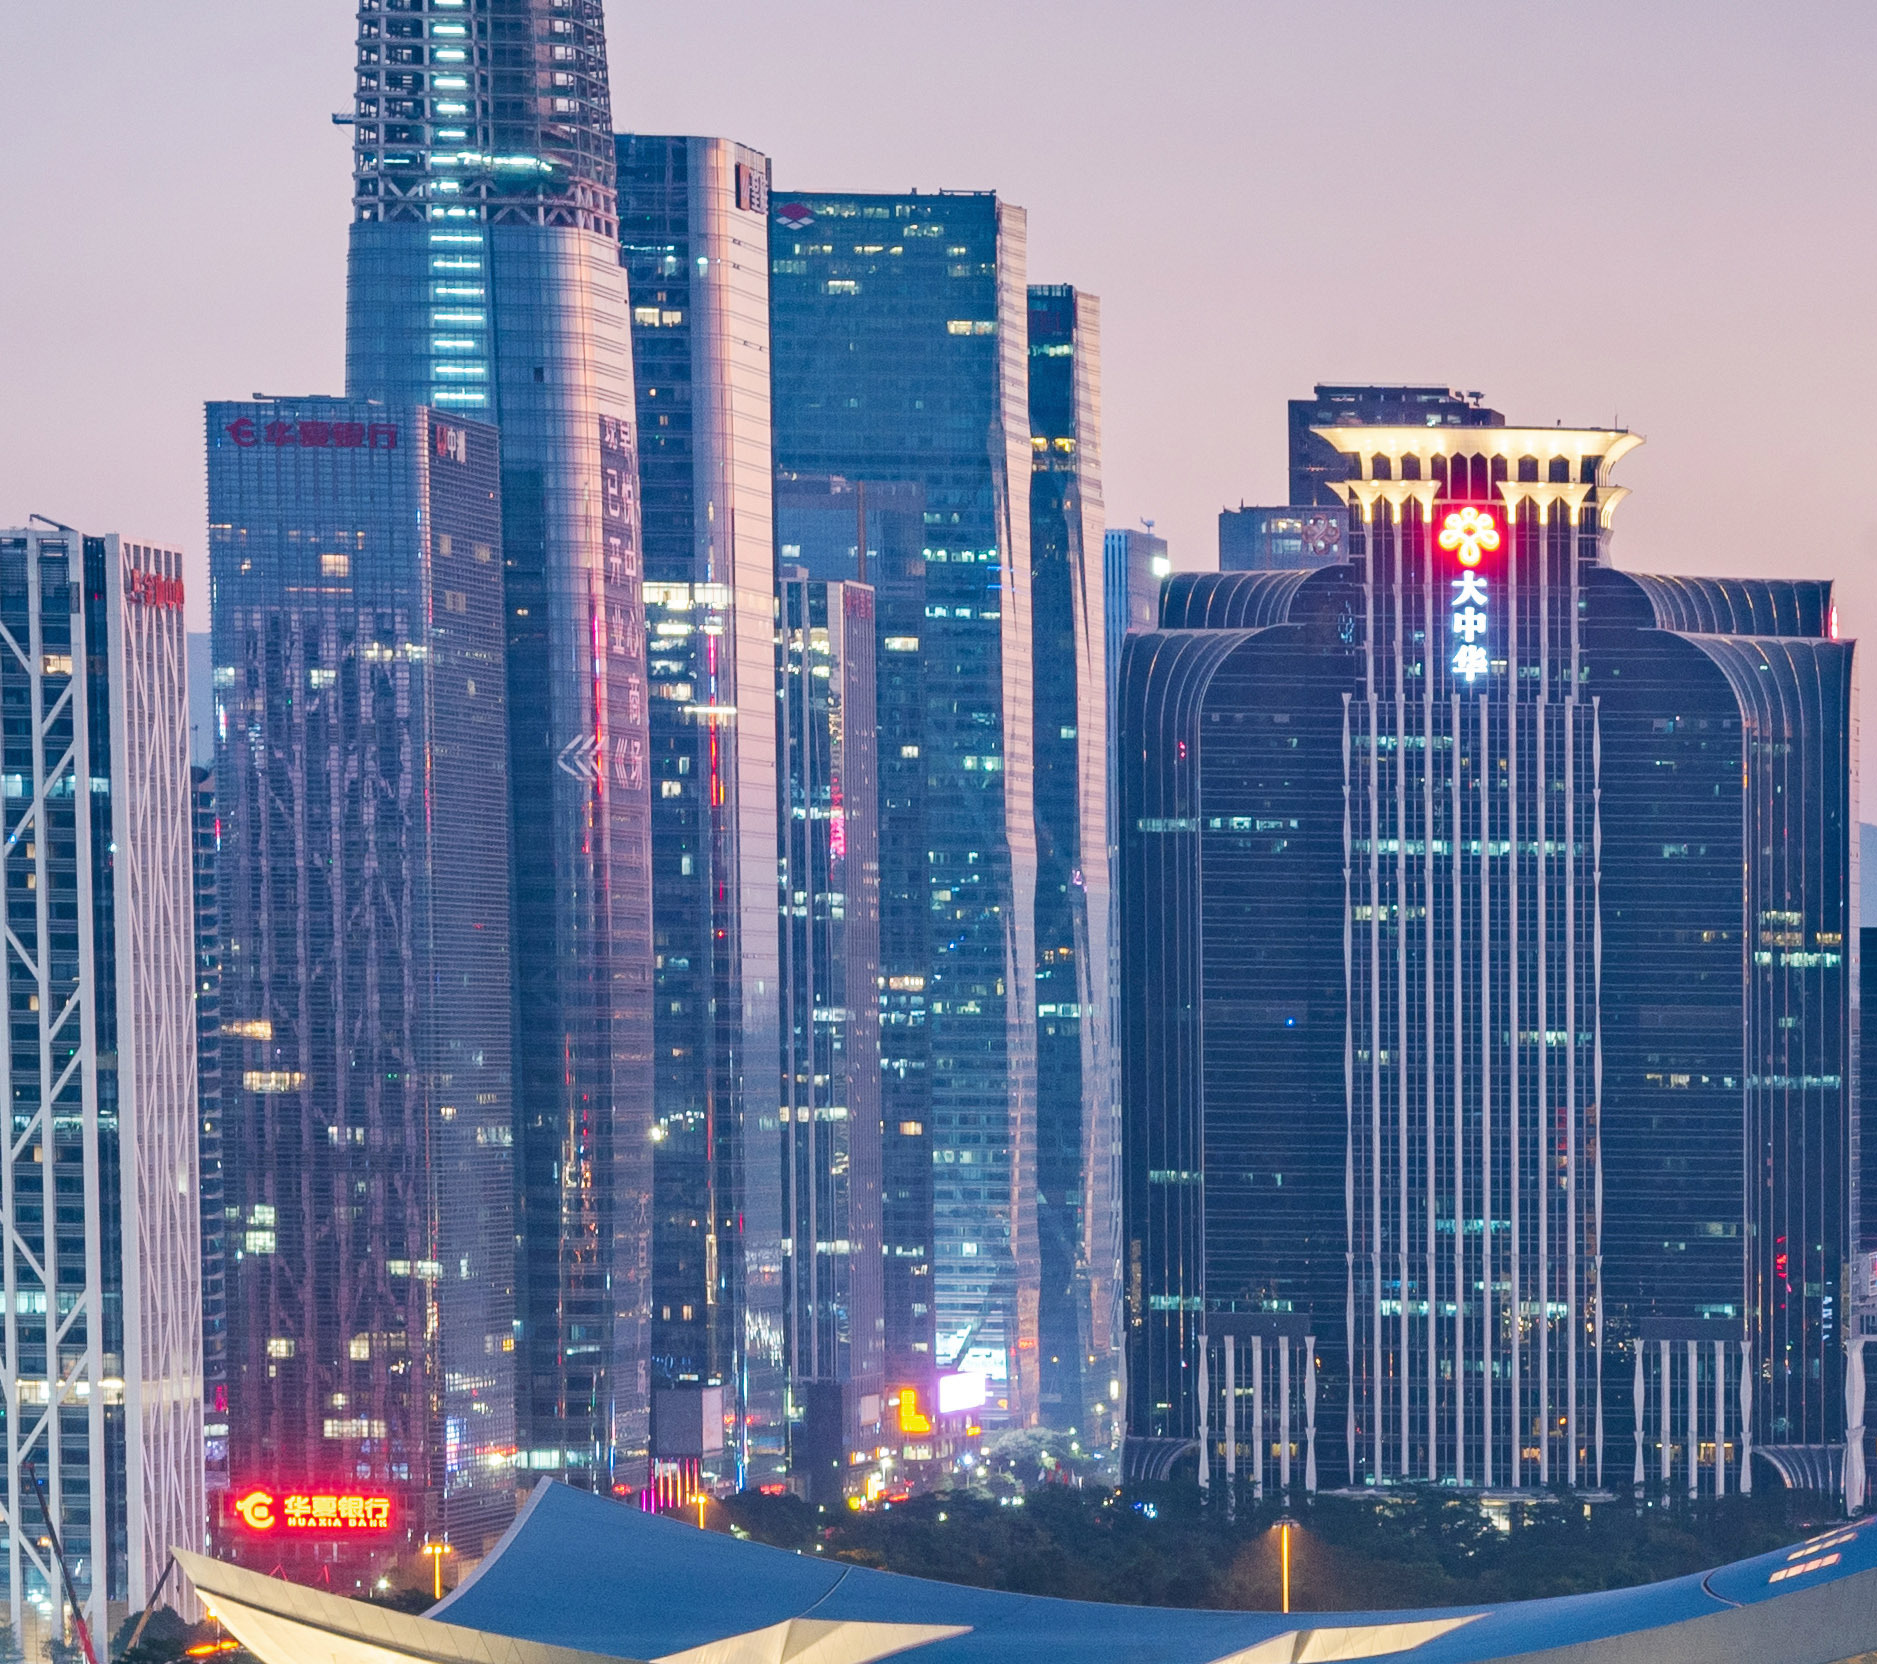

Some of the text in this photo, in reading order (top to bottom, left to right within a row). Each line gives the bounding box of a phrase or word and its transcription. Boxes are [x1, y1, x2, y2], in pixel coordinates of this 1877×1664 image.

[1451, 570, 1488, 682] 大中华
[284, 1495, 390, 1519] 华夏银行
[287, 1518, 388, 1528] HUAXIA BANK
